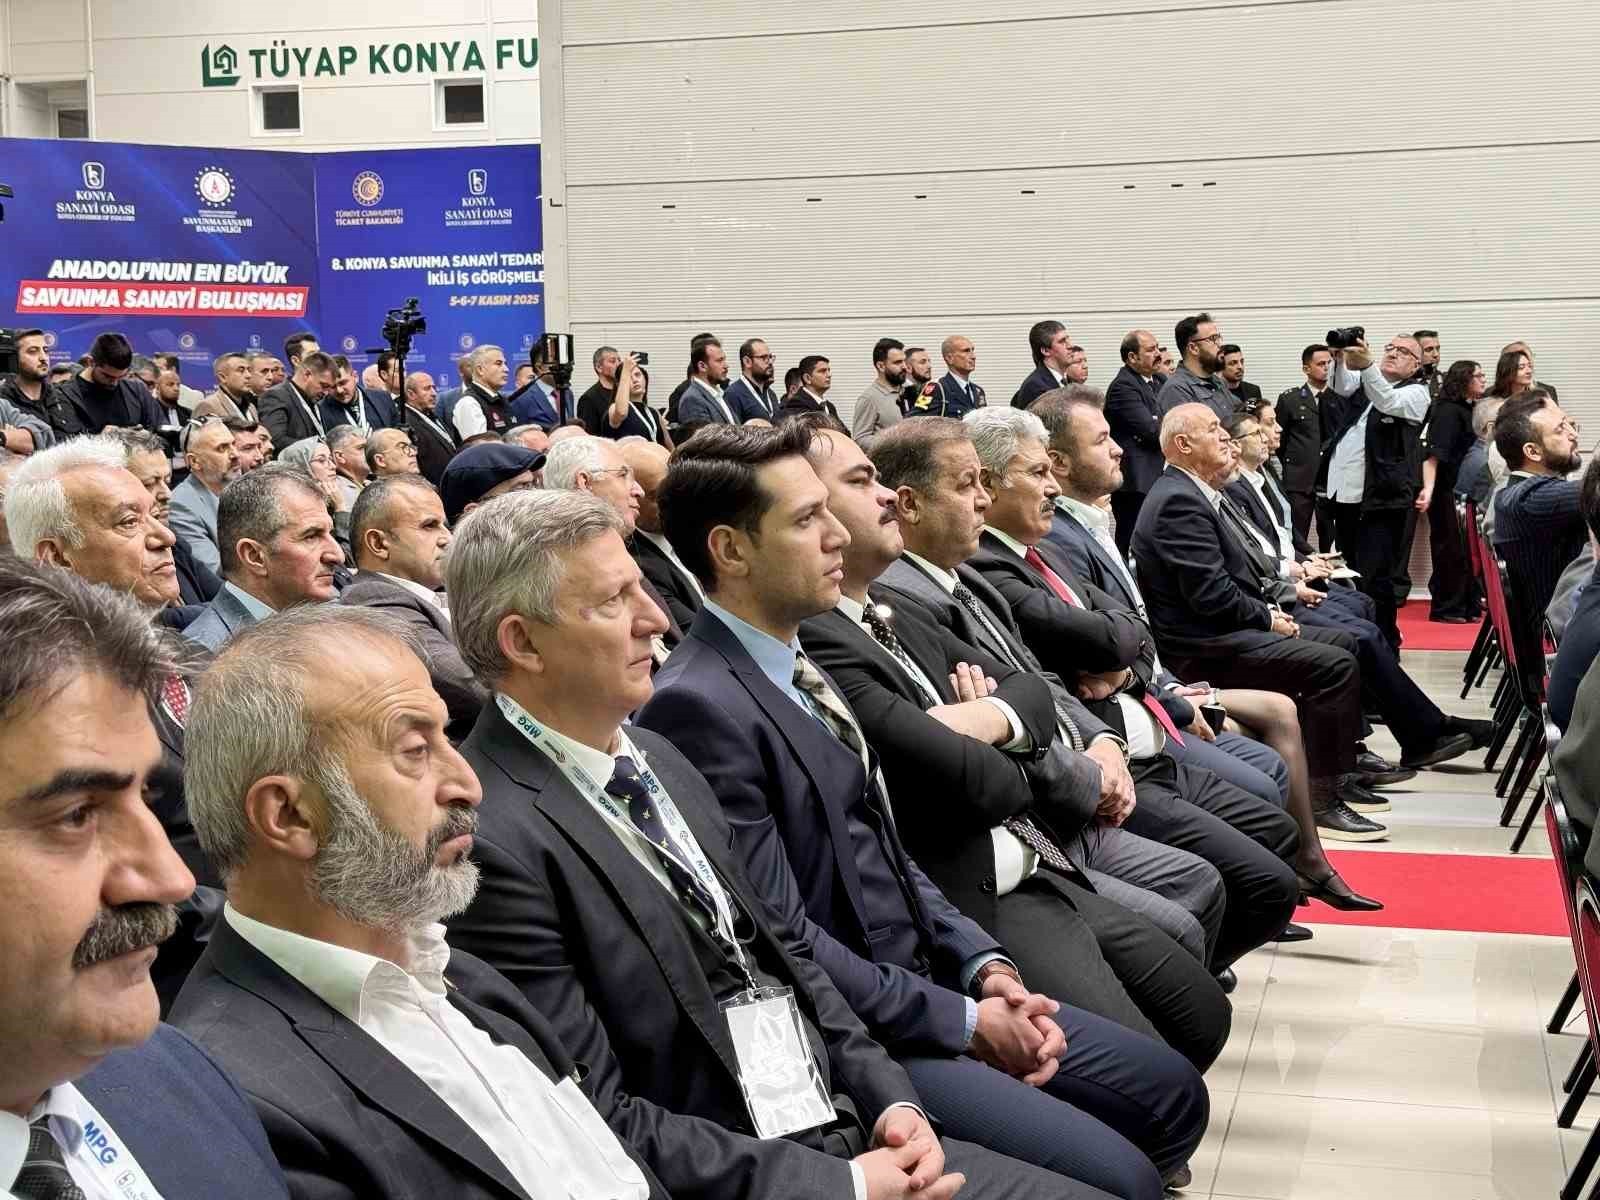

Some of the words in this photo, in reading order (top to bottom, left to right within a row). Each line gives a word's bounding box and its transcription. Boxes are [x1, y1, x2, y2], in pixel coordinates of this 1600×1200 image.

[248, 40, 358, 78] TÜYAP
[369, 40, 485, 74] KONYA
[496, 38, 539, 69] FU
[75, 190, 115, 201] KONYA
[462, 196, 496, 207] KONYA
[56, 201, 98, 214] SANAYİ
[100, 204, 135, 215] ODASI
[445, 207, 480, 220] SANAYİ
[482, 207, 513, 219] ODASI
[331, 257, 344, 271] 8.
[345, 256, 388, 270] KONYA
[389, 255, 450, 269] SAVUNMA
[452, 252, 498, 267] SANAYİ
[47, 259, 192, 281] ANADOLU'NUN
[193, 262, 222, 282] EN
[223, 260, 289, 284] BÜYÜK
[428, 270, 455, 286] İKİLİ
[457, 269, 469, 287] İŞ
[21, 286, 121, 308] SAVUNMA
[122, 286, 197, 309] SANAYİ
[198, 290, 304, 313] BULUŞMASI
[449, 296, 477, 307] 5-6-7
[478, 295, 512, 306] KASIM
[512, 294, 540, 305] 2025
[517, 715, 542, 739] MPG
[641, 770, 660, 795] MPG
[83, 1120, 118, 1165] MPG
